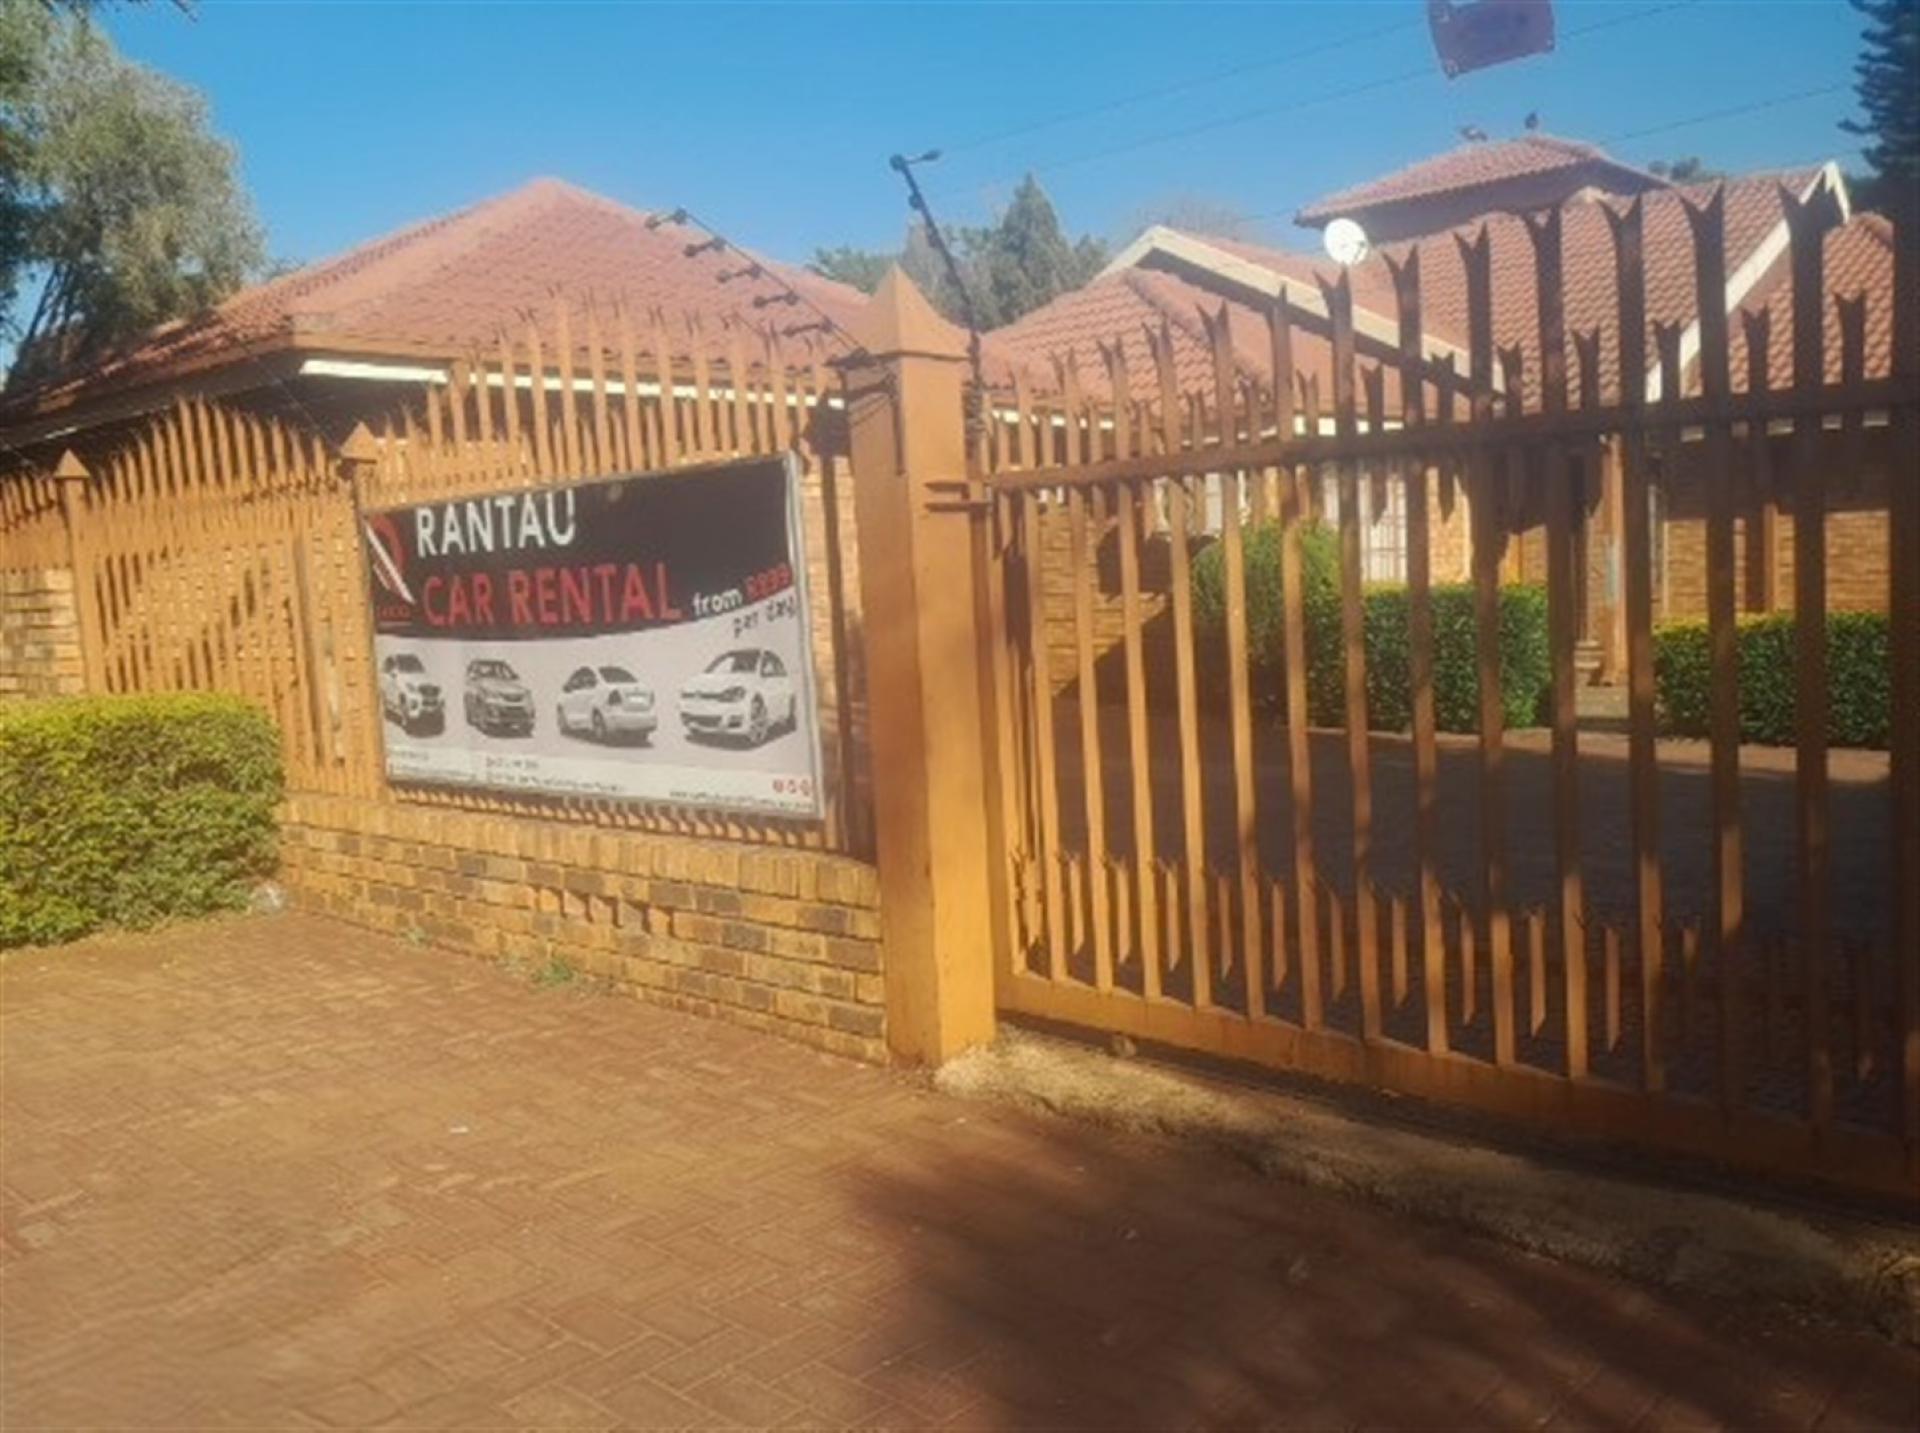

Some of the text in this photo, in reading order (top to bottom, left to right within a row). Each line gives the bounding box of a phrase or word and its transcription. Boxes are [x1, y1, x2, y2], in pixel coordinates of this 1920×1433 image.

[416, 488, 576, 558] RANTAU
[424, 572, 495, 627] CAR
[509, 561, 682, 625] RENTAL
[693, 591, 742, 617] from
